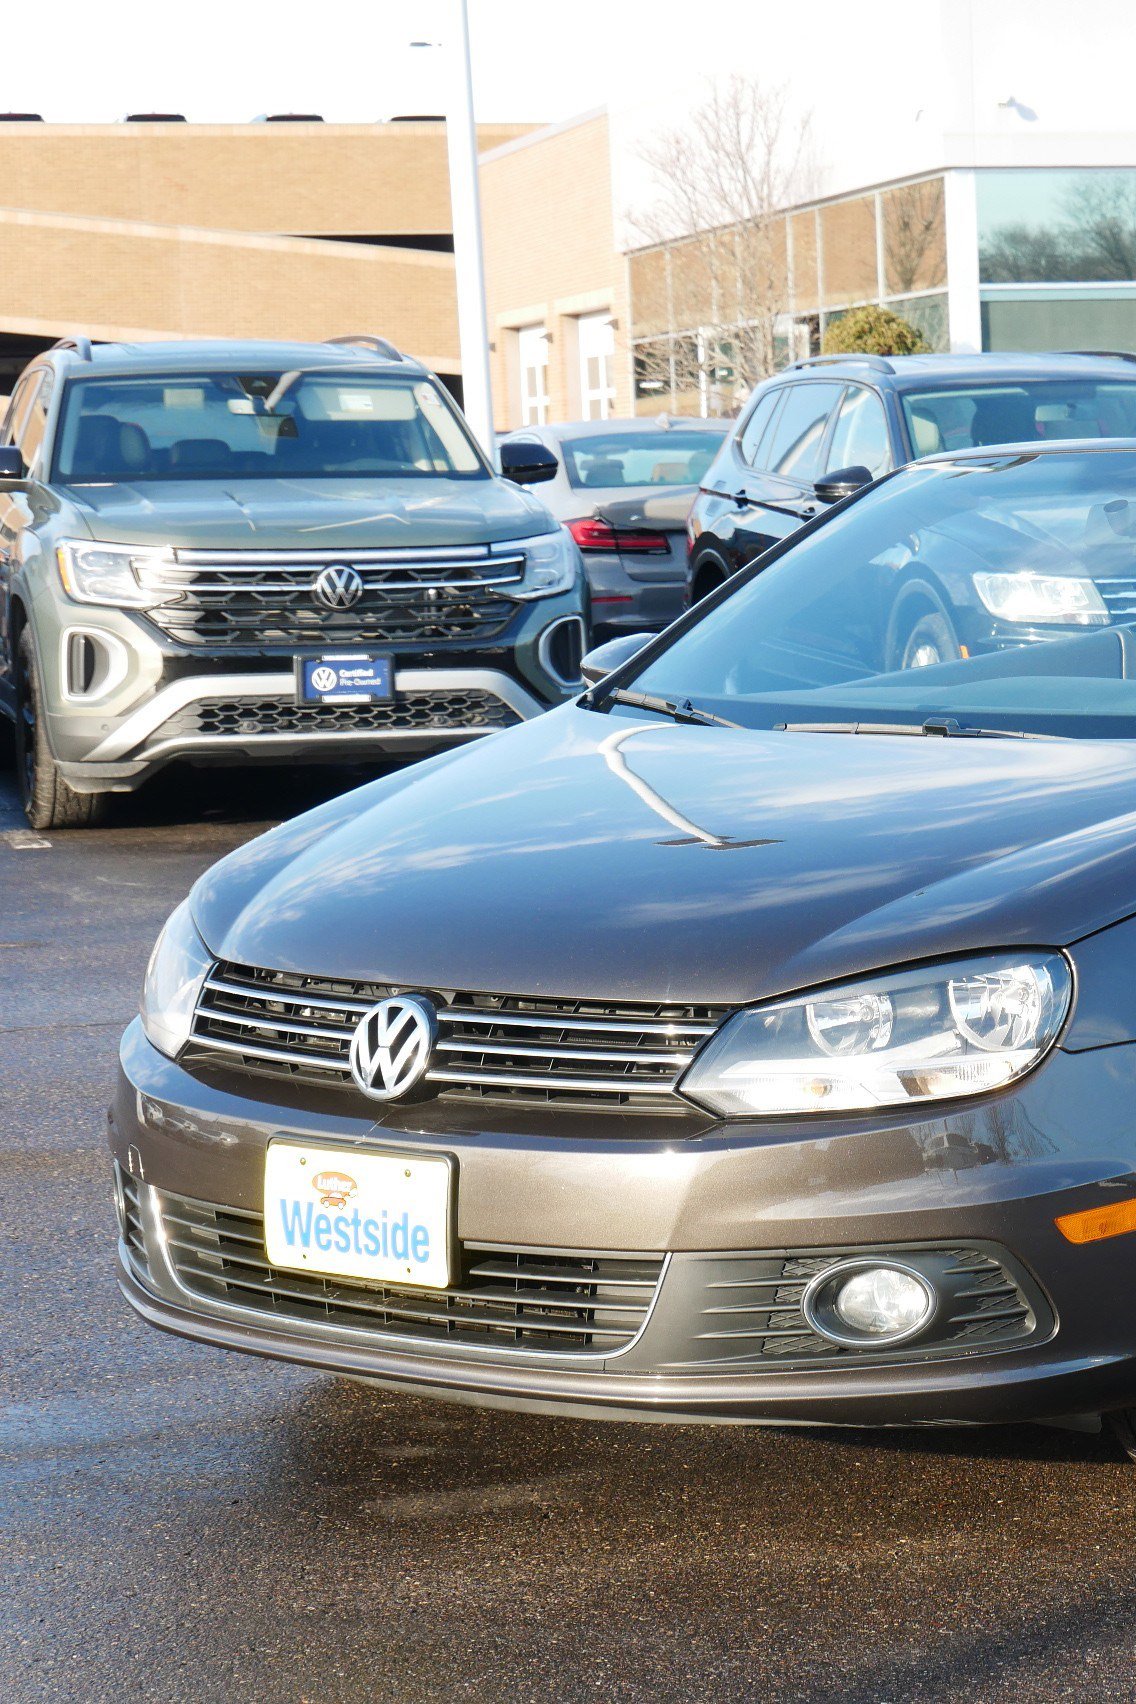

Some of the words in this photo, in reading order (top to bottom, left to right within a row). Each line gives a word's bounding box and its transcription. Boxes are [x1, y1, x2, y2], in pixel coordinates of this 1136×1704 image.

[316, 565, 363, 609] VW
[349, 997, 432, 1102] VW
[280, 1199, 430, 1263] Westside
